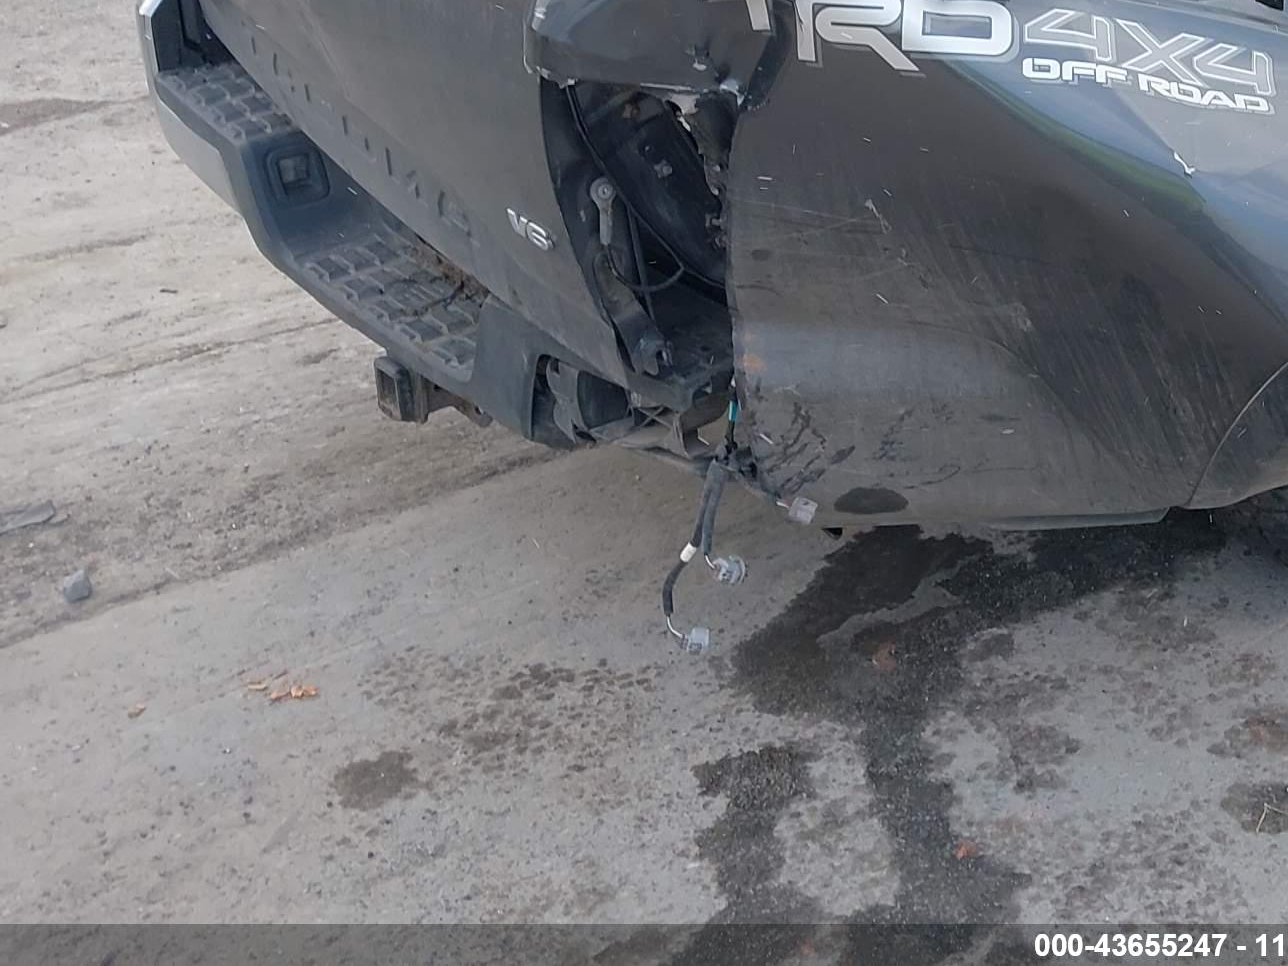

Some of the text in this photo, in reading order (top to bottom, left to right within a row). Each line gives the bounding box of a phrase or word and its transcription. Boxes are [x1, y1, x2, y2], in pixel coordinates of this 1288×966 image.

[1022, 57, 1276, 115] OFF ROAD
[506, 207, 550, 251] V6
